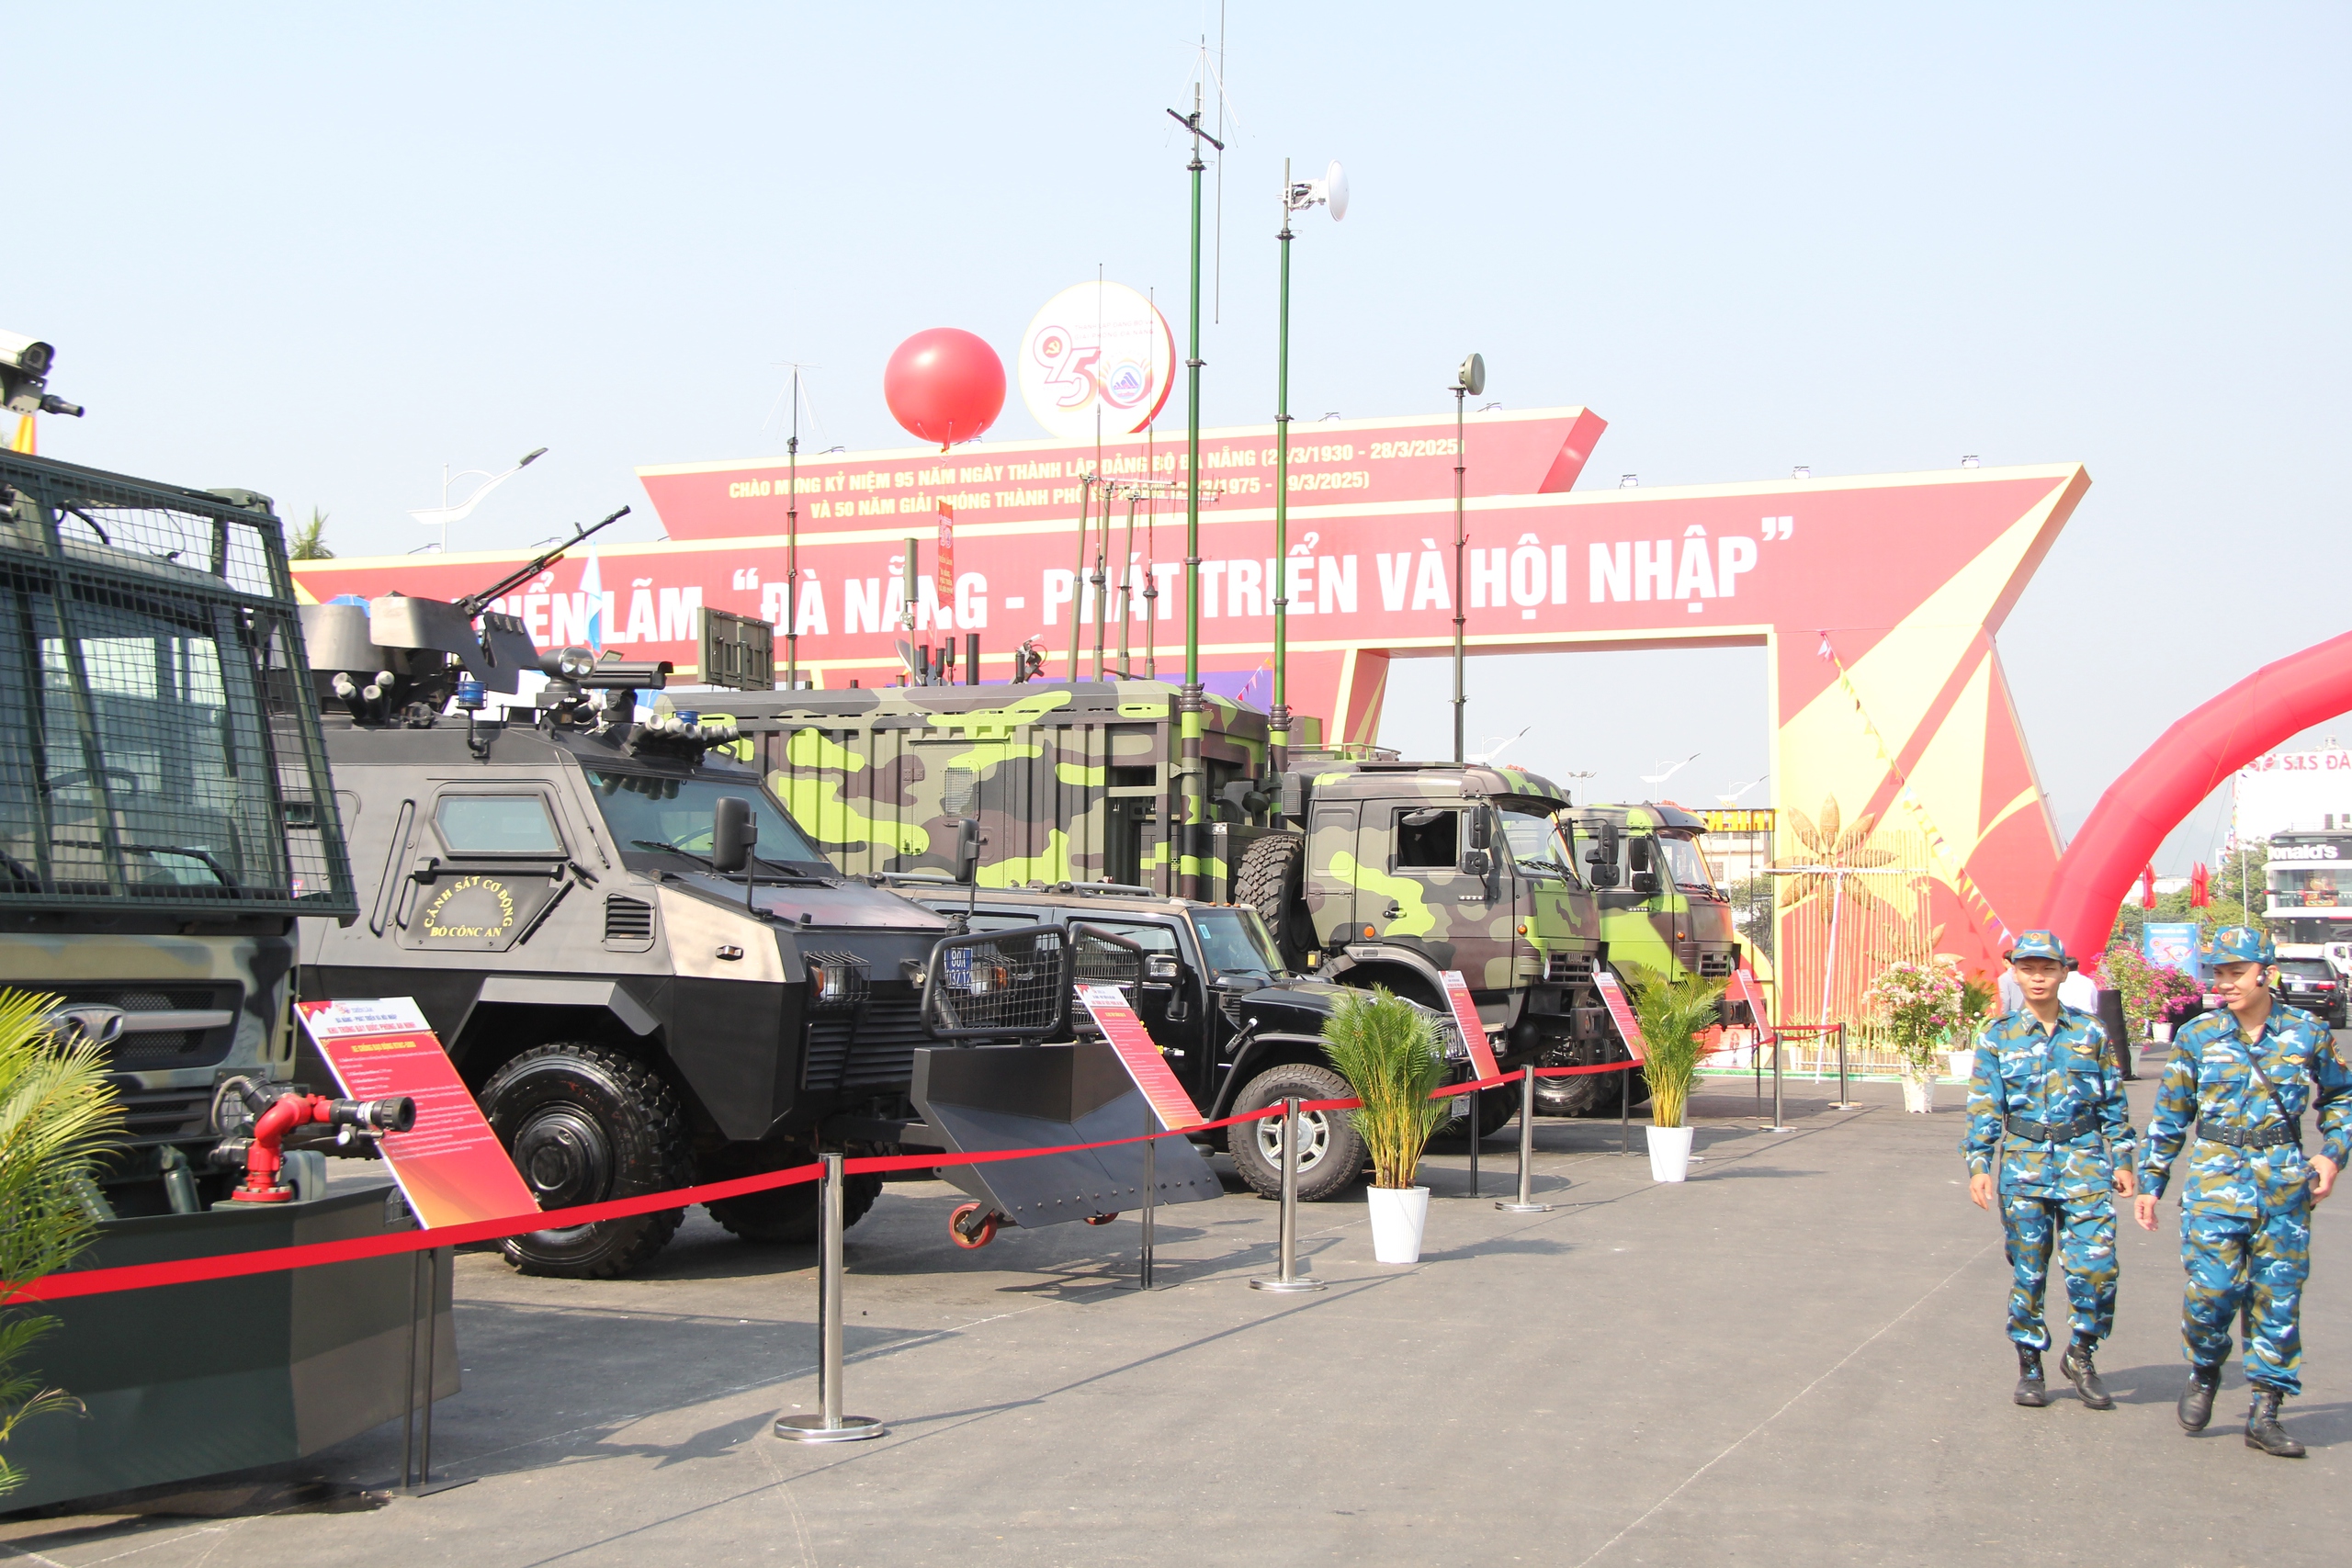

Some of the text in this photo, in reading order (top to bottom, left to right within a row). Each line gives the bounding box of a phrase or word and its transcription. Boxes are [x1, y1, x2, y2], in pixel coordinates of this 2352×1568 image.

[729, 478, 771, 498] CHÀO
[825, 470, 845, 491] KỶ
[849, 470, 890, 493] NIỆM
[895, 471, 914, 488] 95
[918, 467, 956, 487] NĂM
[960, 463, 1003, 483] NGÀY
[1008, 460, 1061, 480] THÀNH
[1101, 452, 1148, 475] ĐẢNG
[1152, 451, 1175, 475] BỘ
[1207, 446, 1256, 468] NẴNG
[1261, 444, 1353, 467] (2/3/1930
[810, 499, 831, 519] VÀ
[835, 501, 854, 517] 50
[858, 496, 895, 516] NĂM
[899, 491, 932, 513] GIẢI
[936, 491, 991, 511] PHÓNG
[995, 487, 1048, 508] THÀNH
[1283, 471, 1369, 491] 9/3/2025)
[602, 577, 703, 644] LÃM
[1005, 596, 1025, 610] -
[1375, 537, 1452, 613] VÀ
[1470, 532, 1567, 621] HỘI
[1589, 514, 1793, 614] NHẬP”
[2325, 750, 2351, 771] ĐÀ
[454, 875, 481, 892] SÁT
[483, 927, 503, 937] AN
